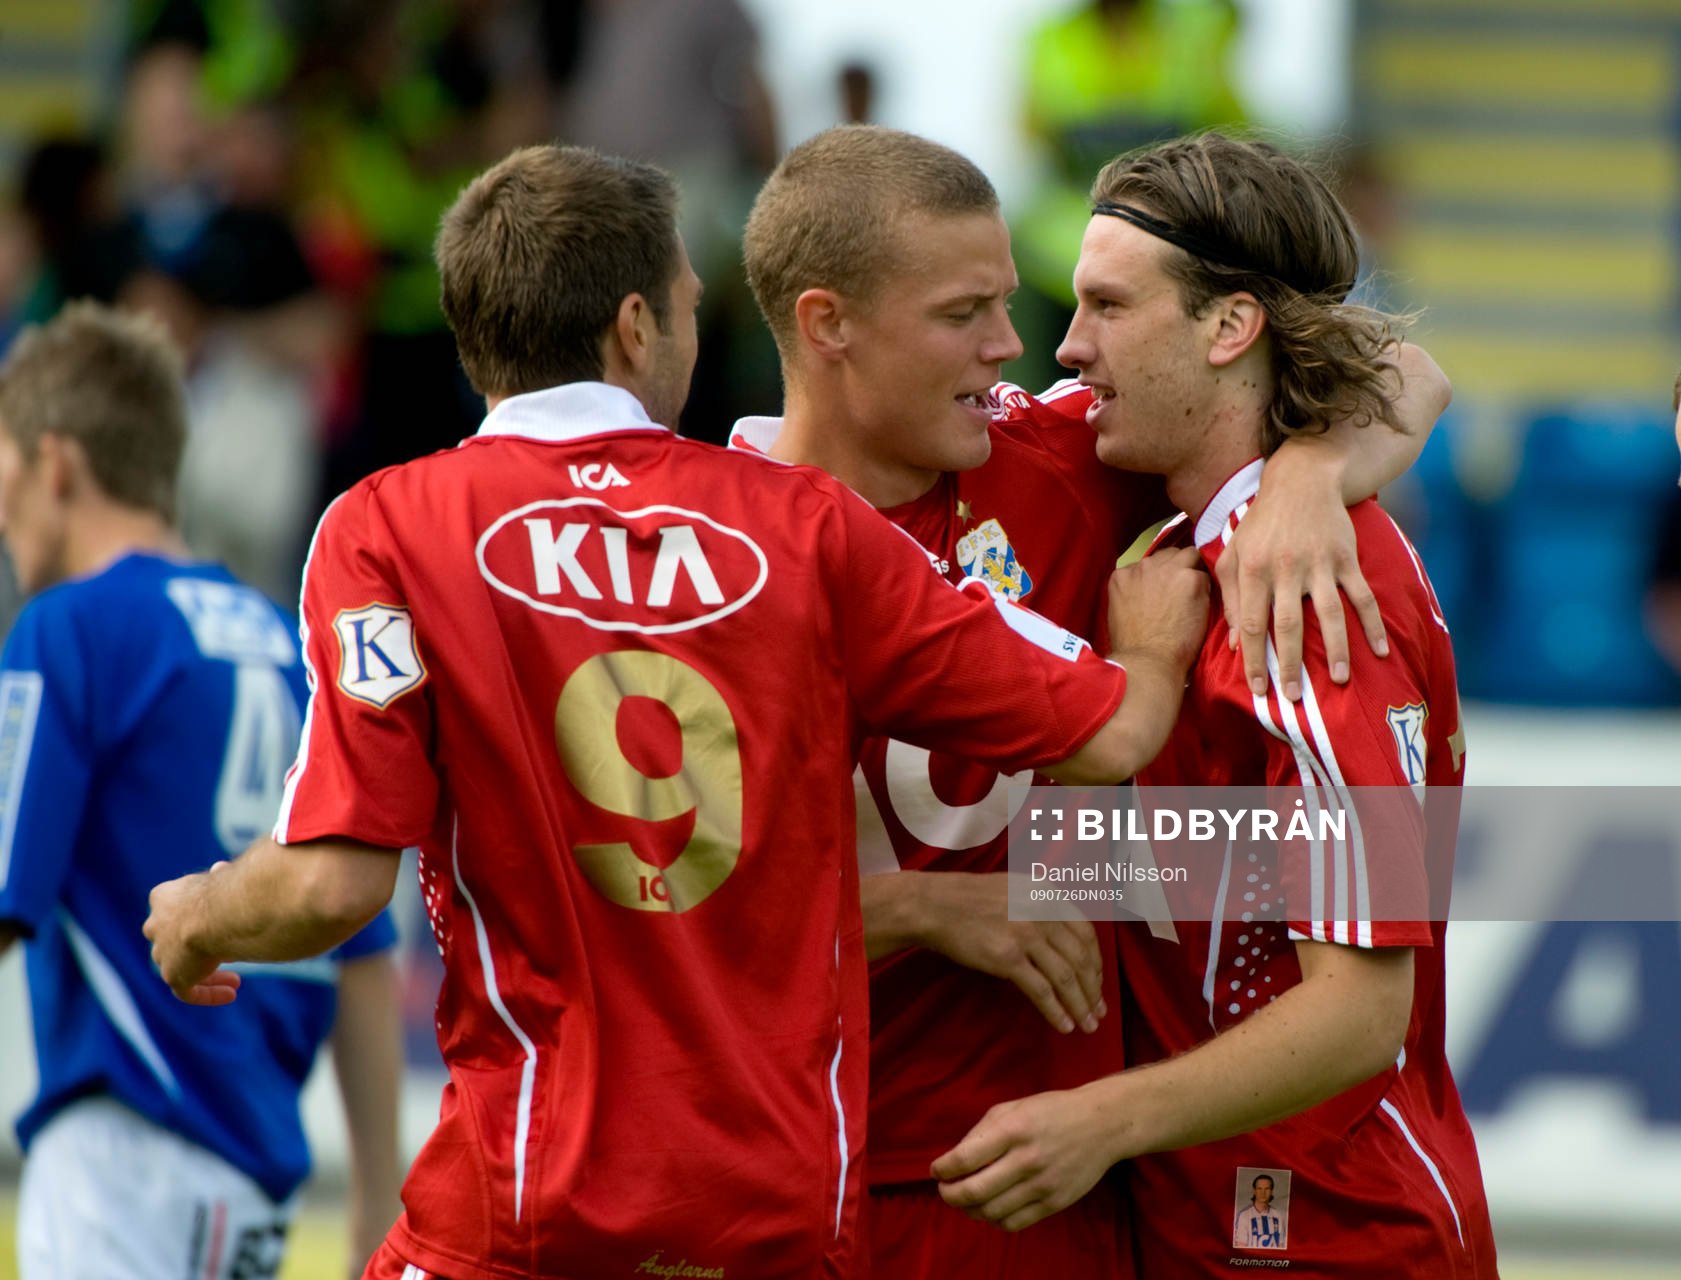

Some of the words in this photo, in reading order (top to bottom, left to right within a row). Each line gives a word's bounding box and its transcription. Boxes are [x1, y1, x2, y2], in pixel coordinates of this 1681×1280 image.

[568, 463, 631, 491] ICA
[523, 518, 726, 608] KIA
[345, 614, 412, 685] K
[554, 649, 744, 914] 9
[1395, 716, 1427, 786] K
